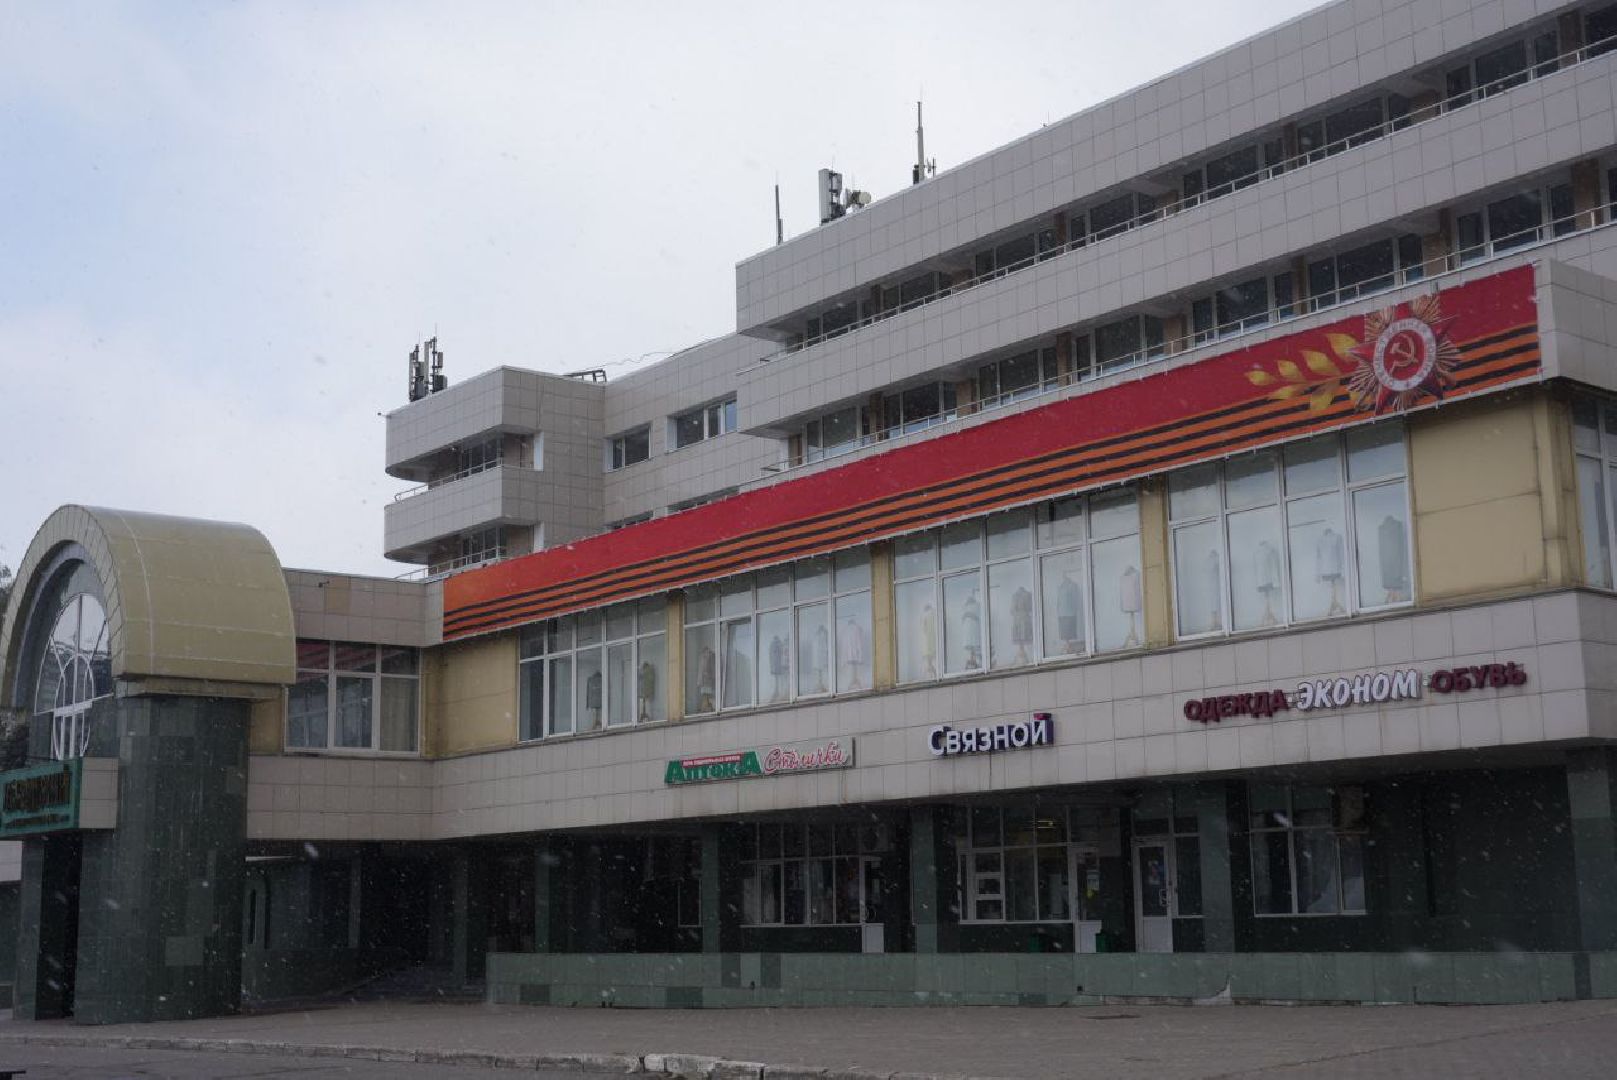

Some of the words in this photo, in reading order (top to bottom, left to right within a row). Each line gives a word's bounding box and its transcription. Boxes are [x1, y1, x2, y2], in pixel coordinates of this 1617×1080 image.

[1184, 689, 1289, 722] ОДЕЖДА
[1297, 670, 1418, 711] ЭКОНОМ
[1430, 662, 1526, 693] ОБУВЬ
